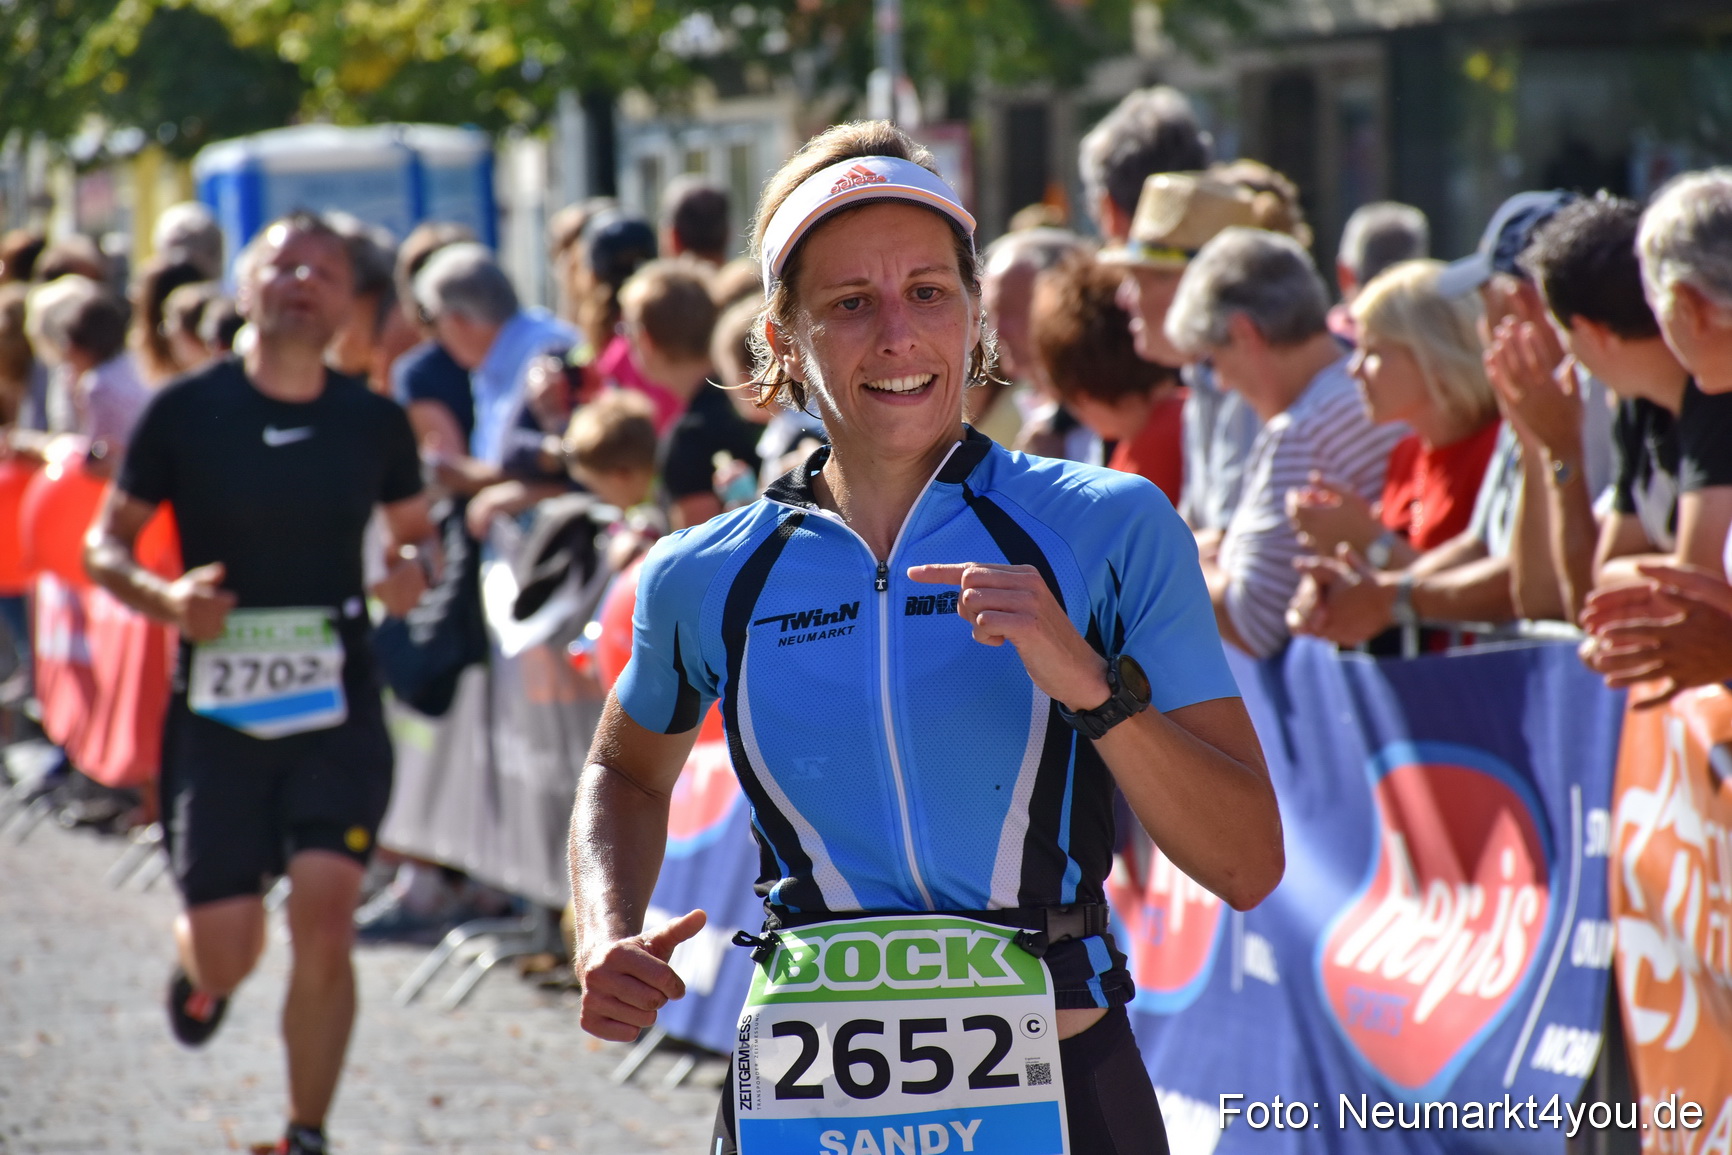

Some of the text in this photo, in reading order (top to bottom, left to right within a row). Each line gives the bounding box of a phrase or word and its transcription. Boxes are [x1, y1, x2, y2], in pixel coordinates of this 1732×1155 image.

[830, 174, 887, 195] adidas
[778, 625, 855, 647] NEUMARKT
[211, 656, 323, 697] 2702
[768, 930, 1022, 994] BOCK
[771, 1014, 1021, 1101] 2652
[819, 1119, 983, 1155] SANDY
